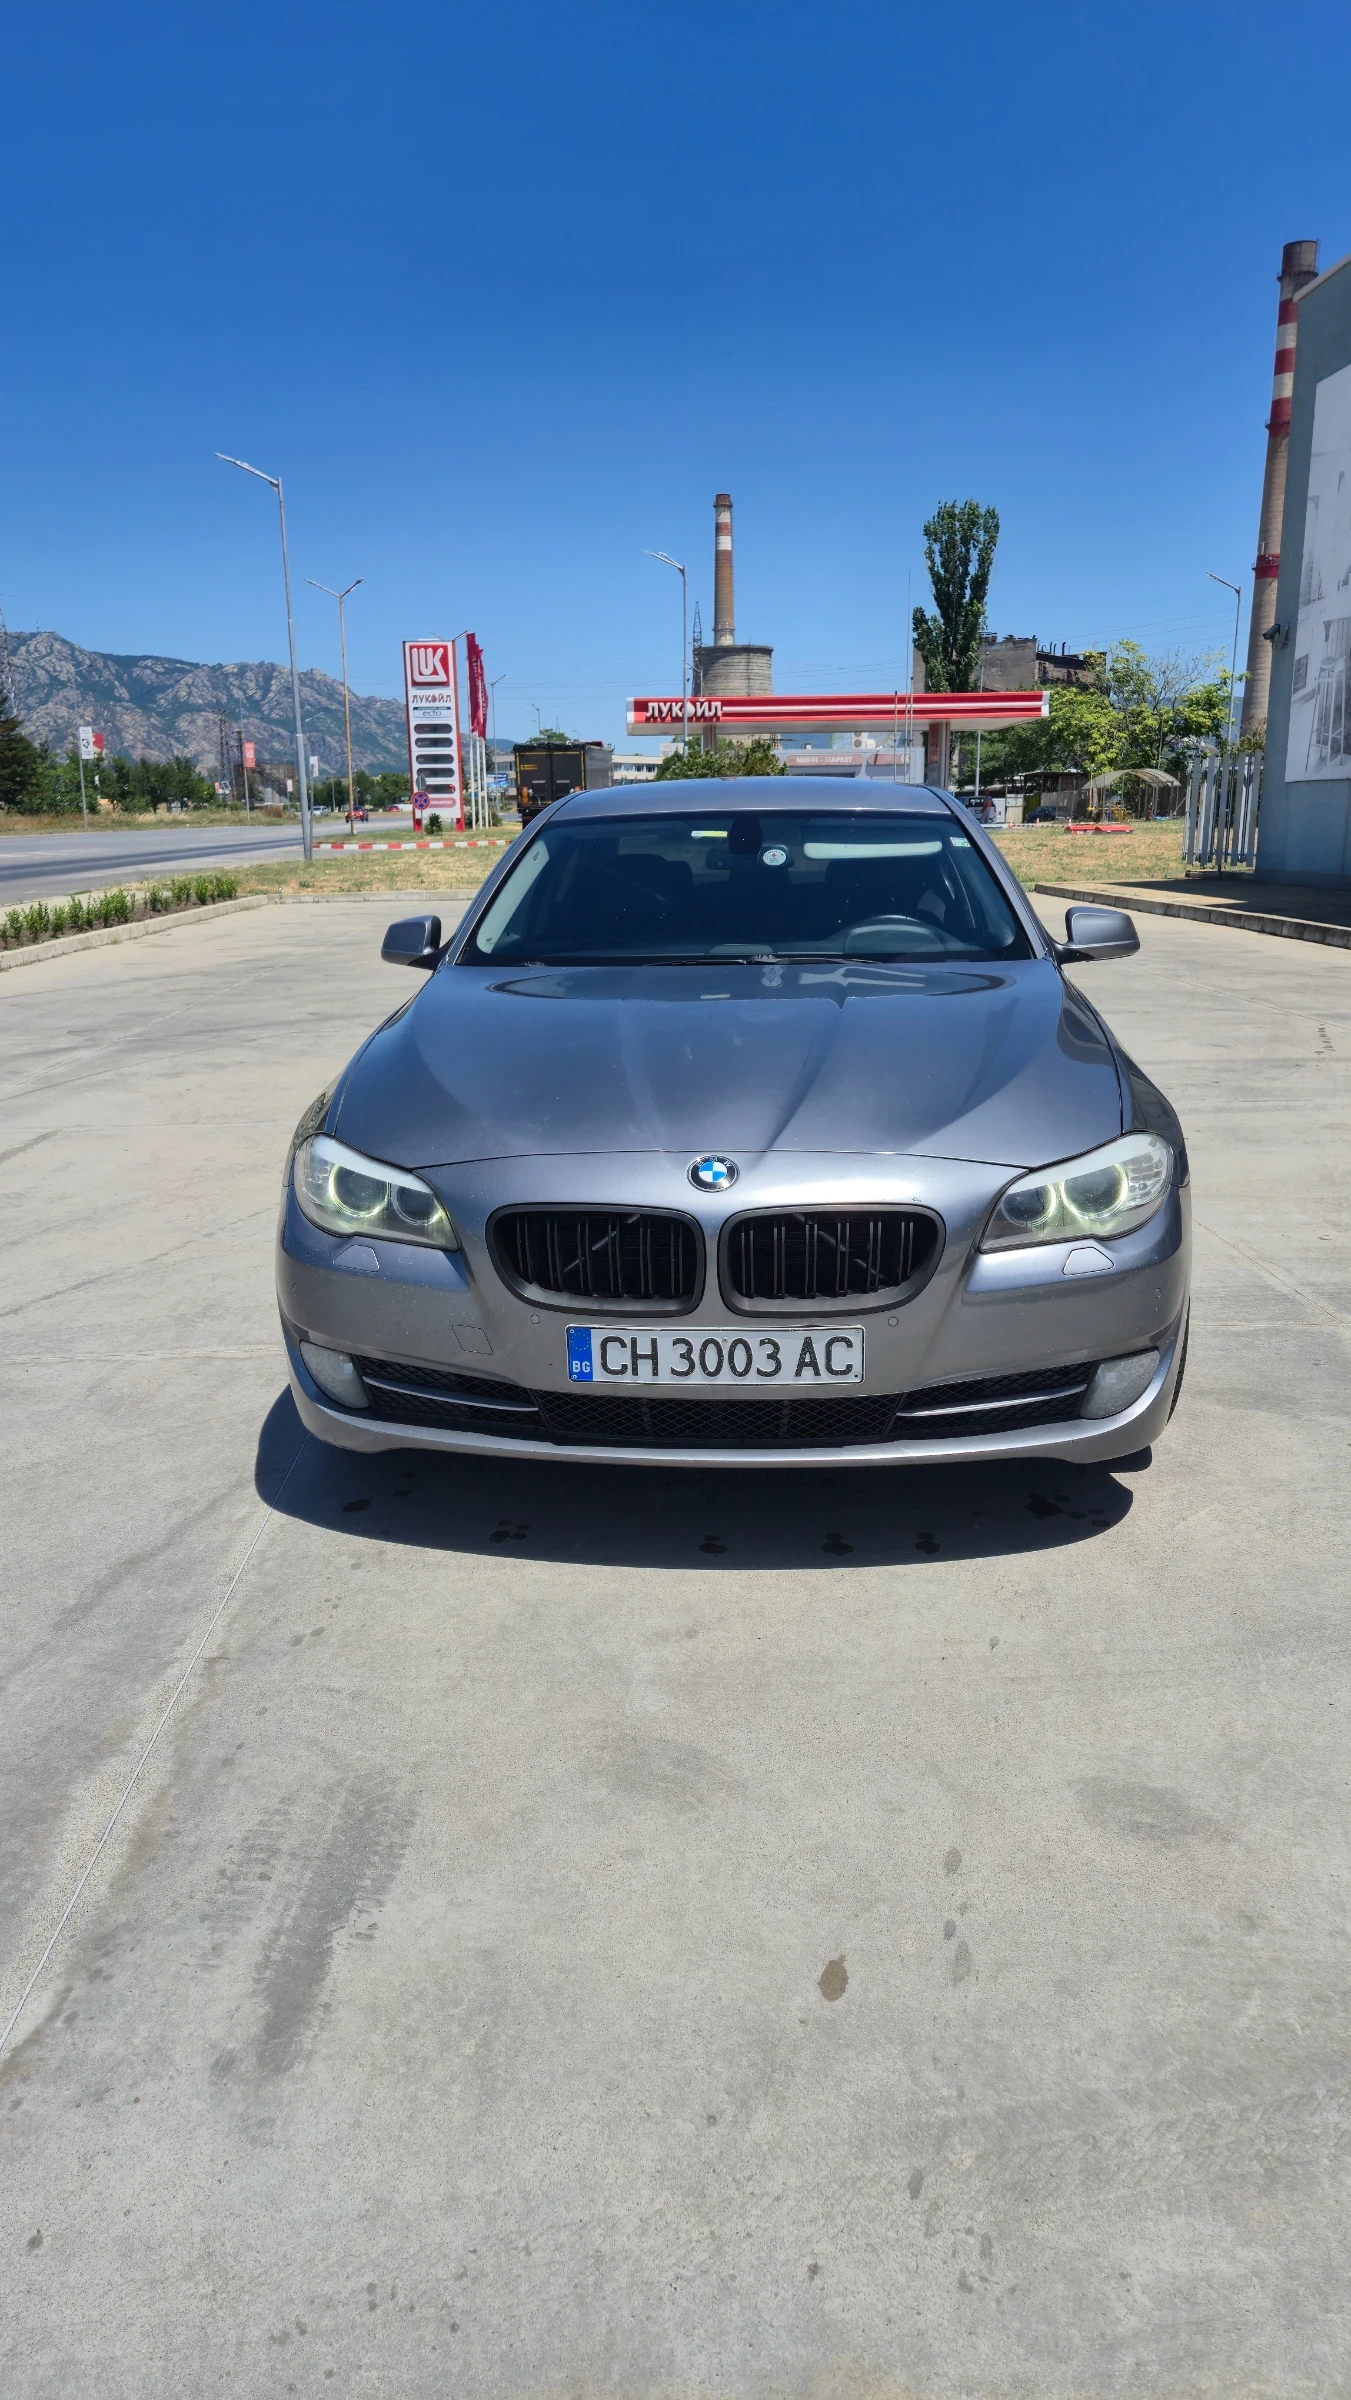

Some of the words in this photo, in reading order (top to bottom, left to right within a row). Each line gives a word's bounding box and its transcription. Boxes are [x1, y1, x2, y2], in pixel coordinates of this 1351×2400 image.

[411, 693, 452, 704] ЛУКОЙЛ
[645, 698, 722, 718] ЛУКОЙЛ
[796, 756, 819, 764] МИНИ
[600, 1336, 659, 1376] CH
[670, 1337, 782, 1377] 3003
[794, 1336, 853, 1377] AC
[572, 1361, 591, 1373] BG
